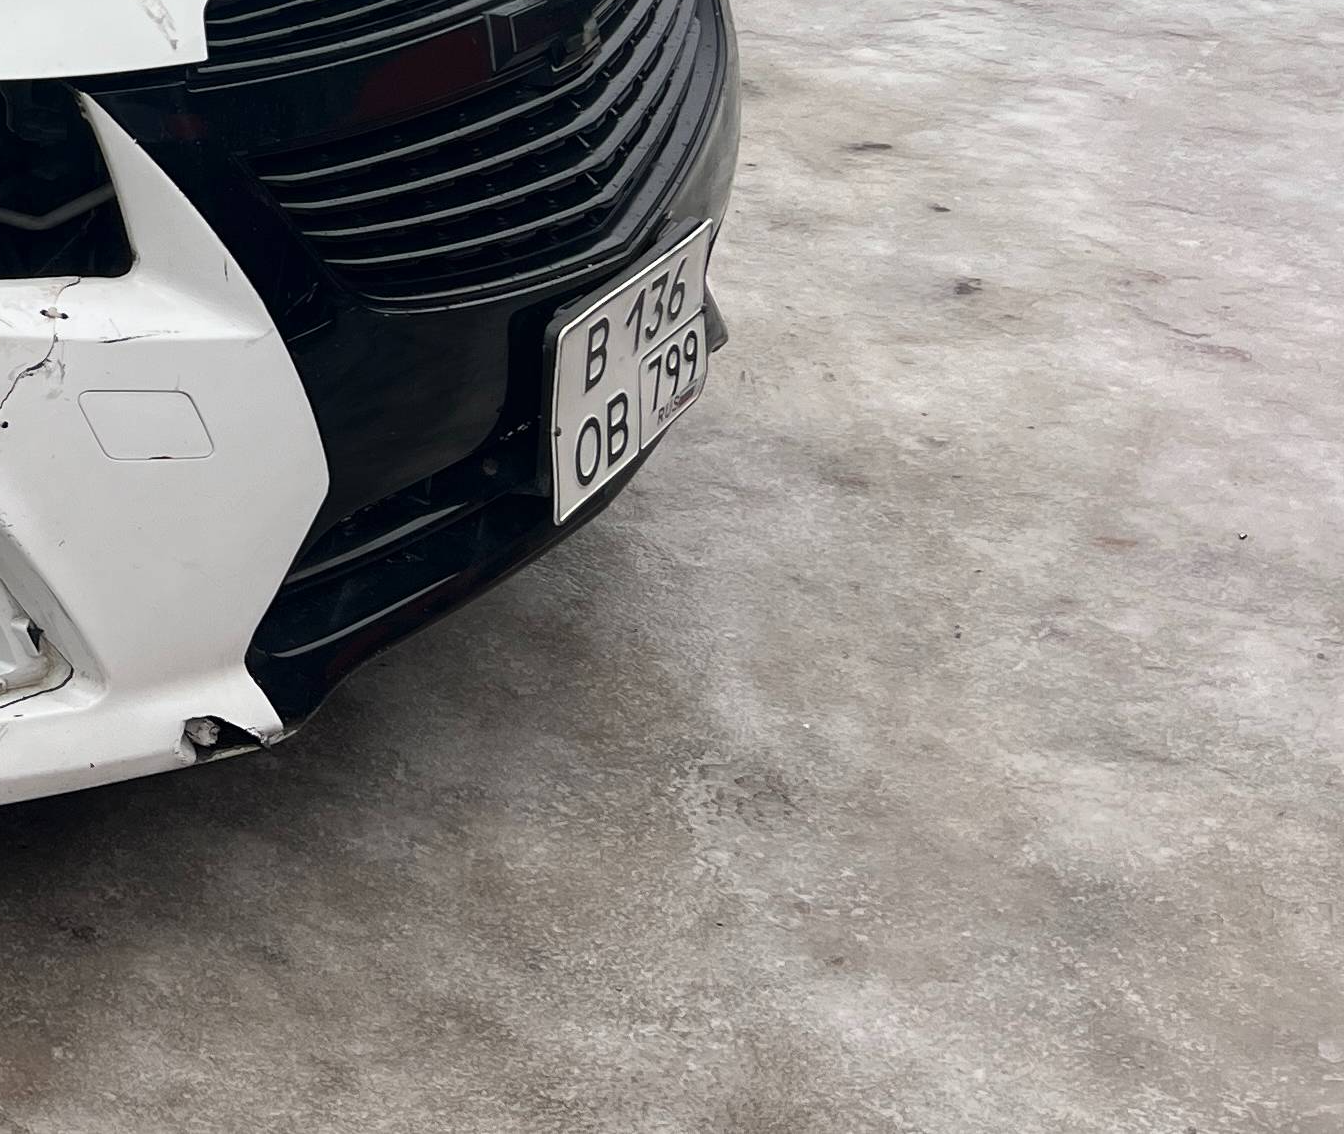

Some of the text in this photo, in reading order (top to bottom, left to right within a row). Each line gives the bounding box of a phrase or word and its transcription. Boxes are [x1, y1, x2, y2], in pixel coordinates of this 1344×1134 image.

[625, 257, 687, 353] 136
[647, 330, 698, 412] 799
[656, 396, 681, 426] RUS
